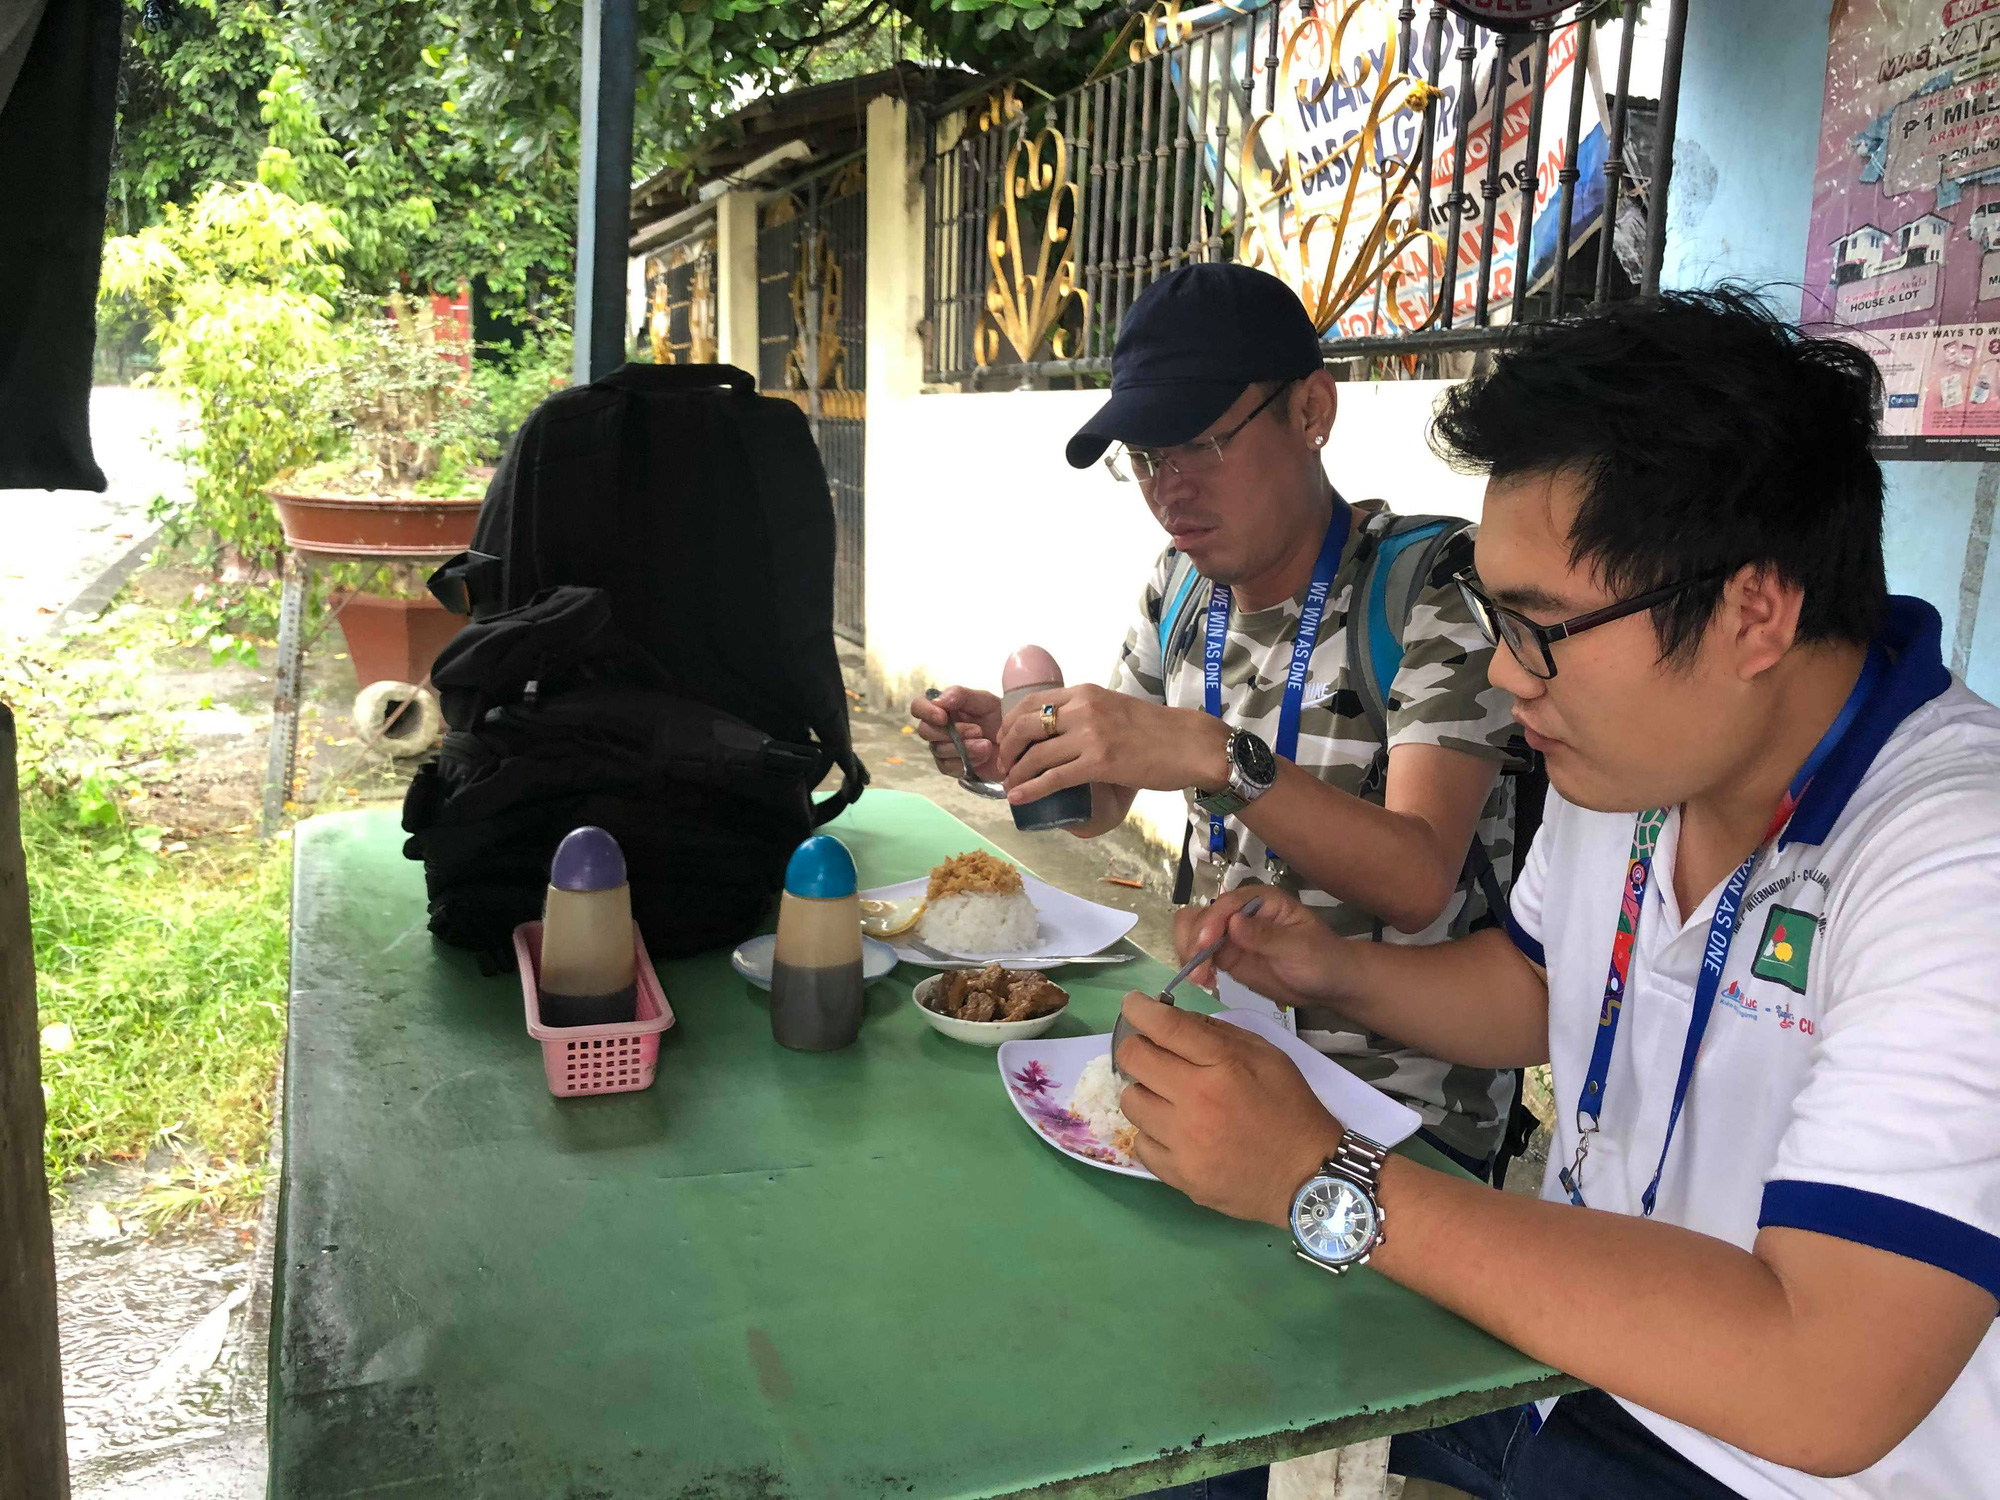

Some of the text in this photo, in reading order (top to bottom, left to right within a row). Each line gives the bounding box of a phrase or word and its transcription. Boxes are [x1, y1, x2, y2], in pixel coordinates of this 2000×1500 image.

[1850, 289, 1920, 313] HOUSE & LOT
[1890, 333, 1896, 341] 2
[1900, 331, 1928, 341] EASY
[1933, 329, 1964, 339] WAYS
[1969, 327, 1984, 336] TO
[1205, 587, 1229, 690] WE WIN AS ONE
[1287, 582, 1329, 691] WE WIN AS ONE
[1303, 682, 1330, 699] NIKE
[1715, 896, 1736, 929] AS
[1703, 930, 1728, 977] ONE
